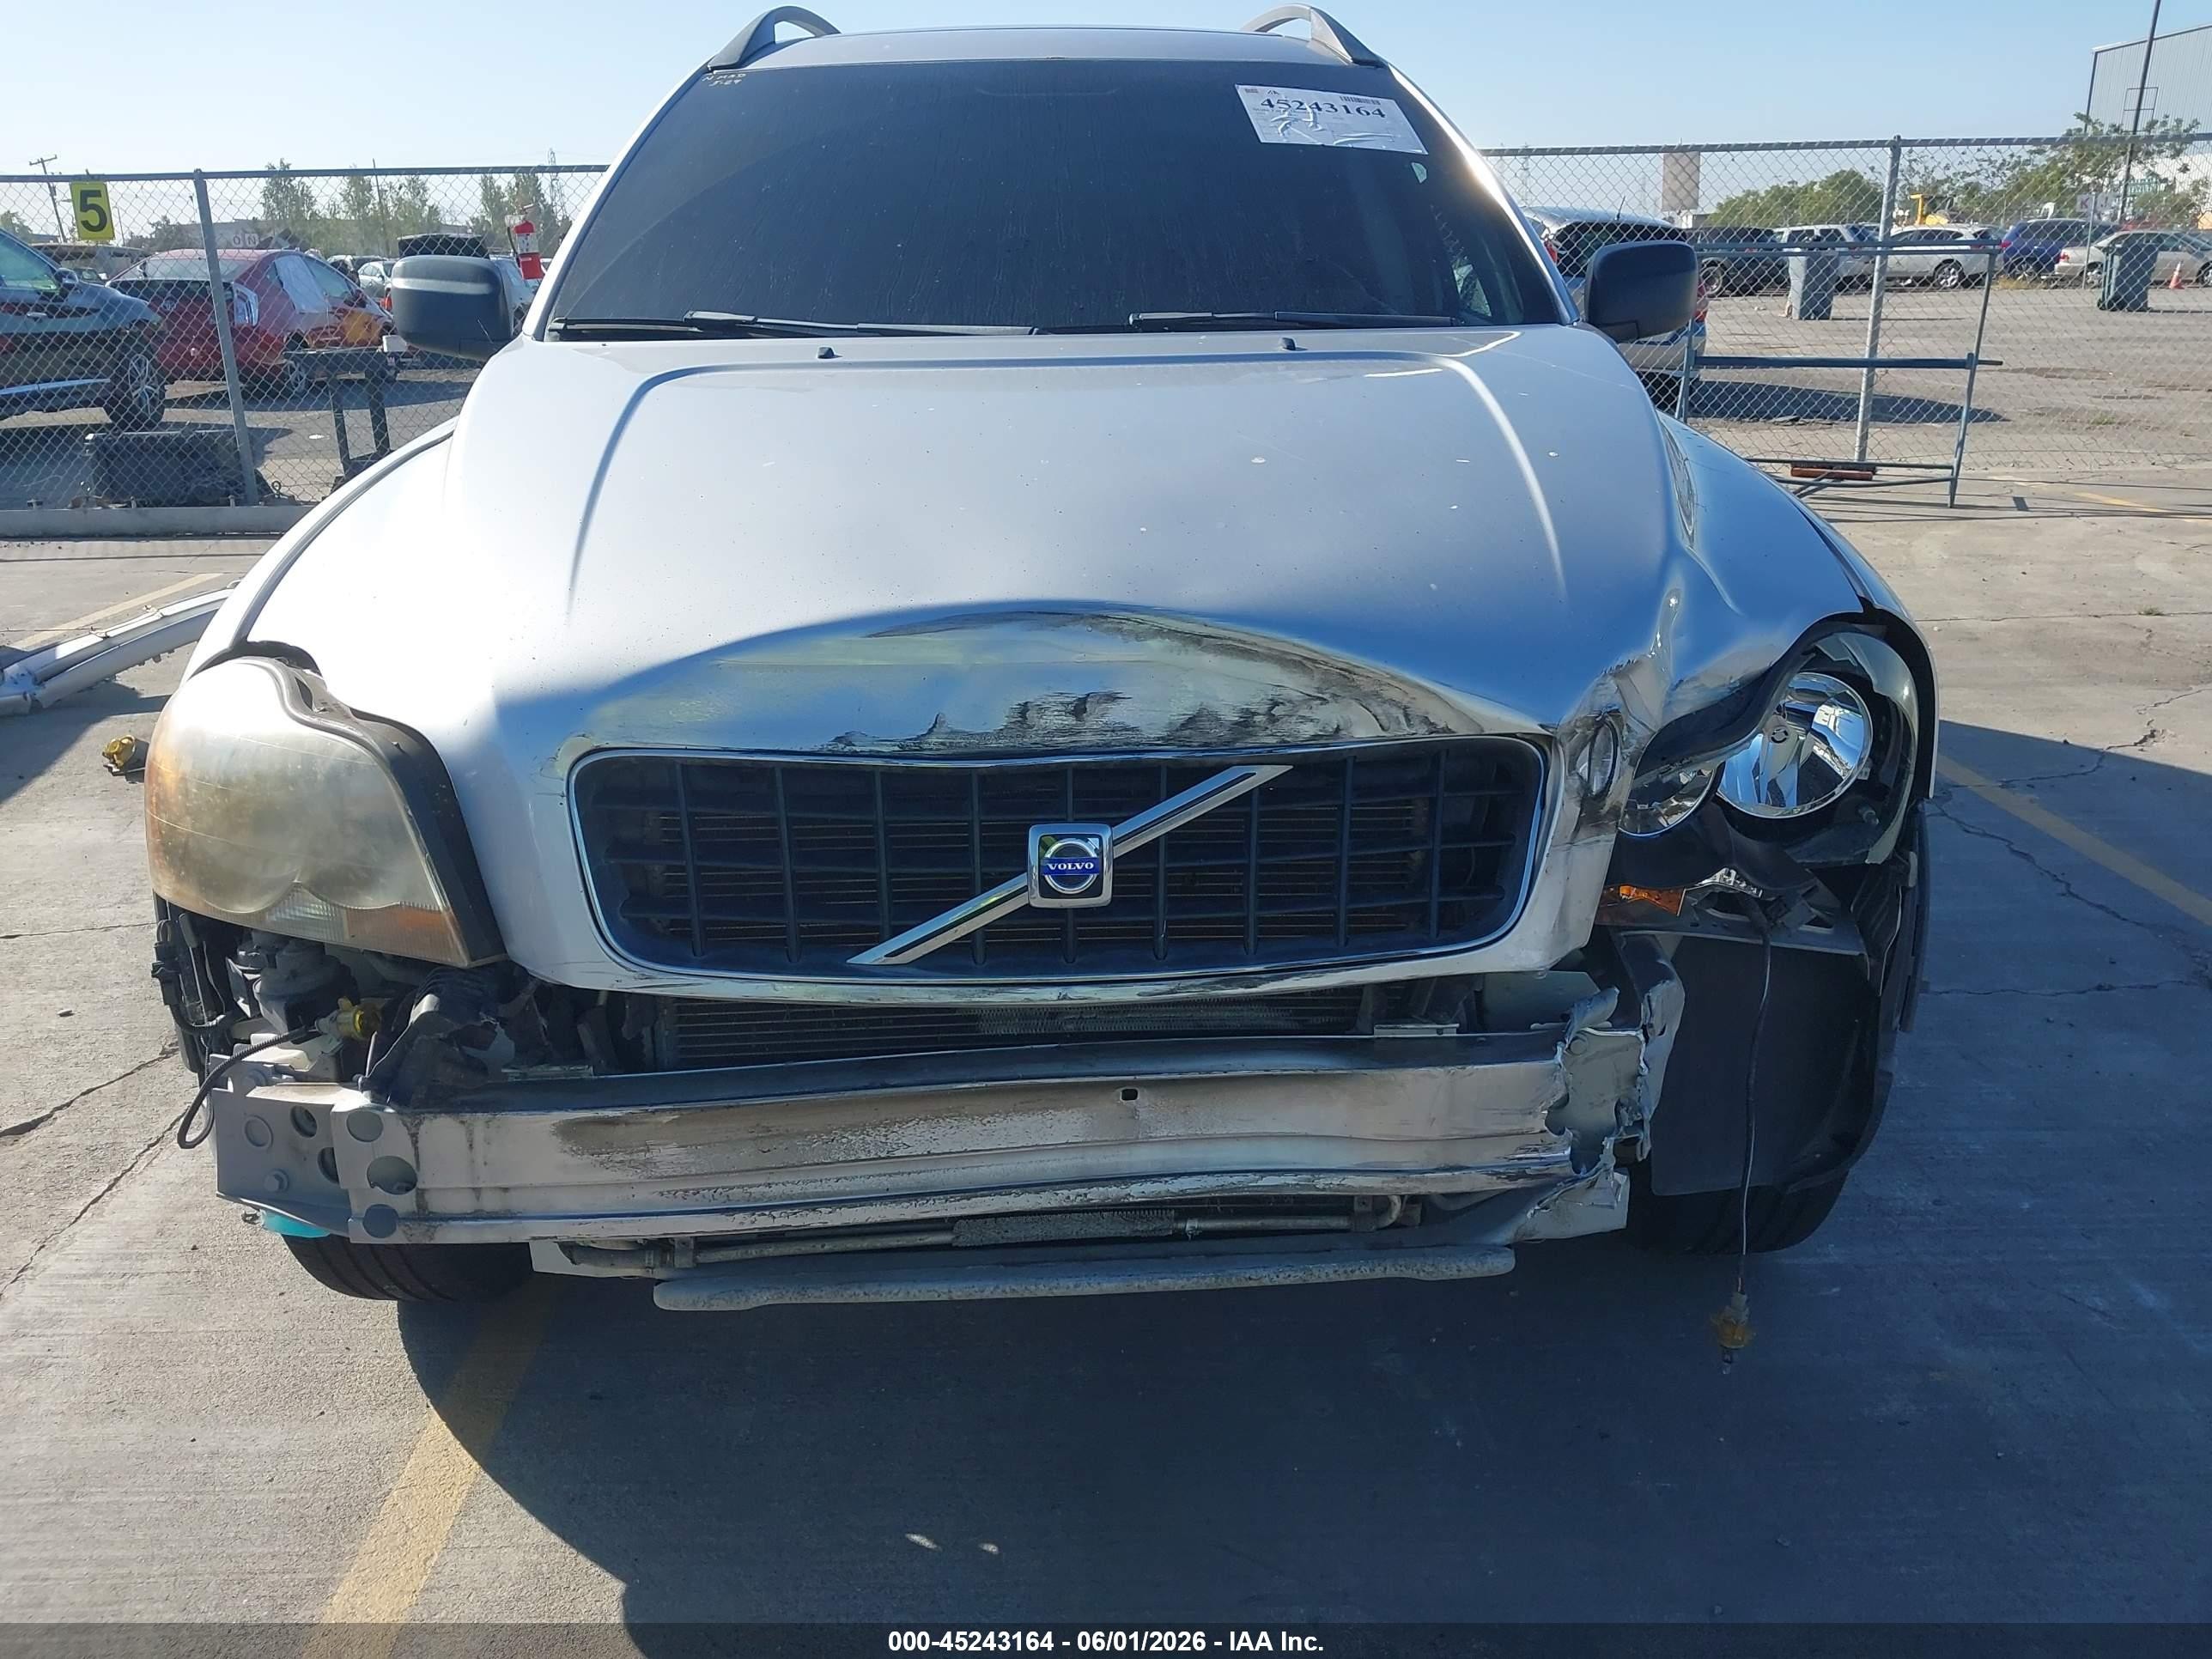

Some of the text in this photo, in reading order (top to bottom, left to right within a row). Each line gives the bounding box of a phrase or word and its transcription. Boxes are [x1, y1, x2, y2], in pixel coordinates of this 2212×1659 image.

[1261, 97, 1386, 118] 45243164
[2081, 198, 2089, 209] K
[80, 190, 107, 233] 5
[247, 235, 256, 246] N
[1047, 862, 1095, 871] VOLVO
